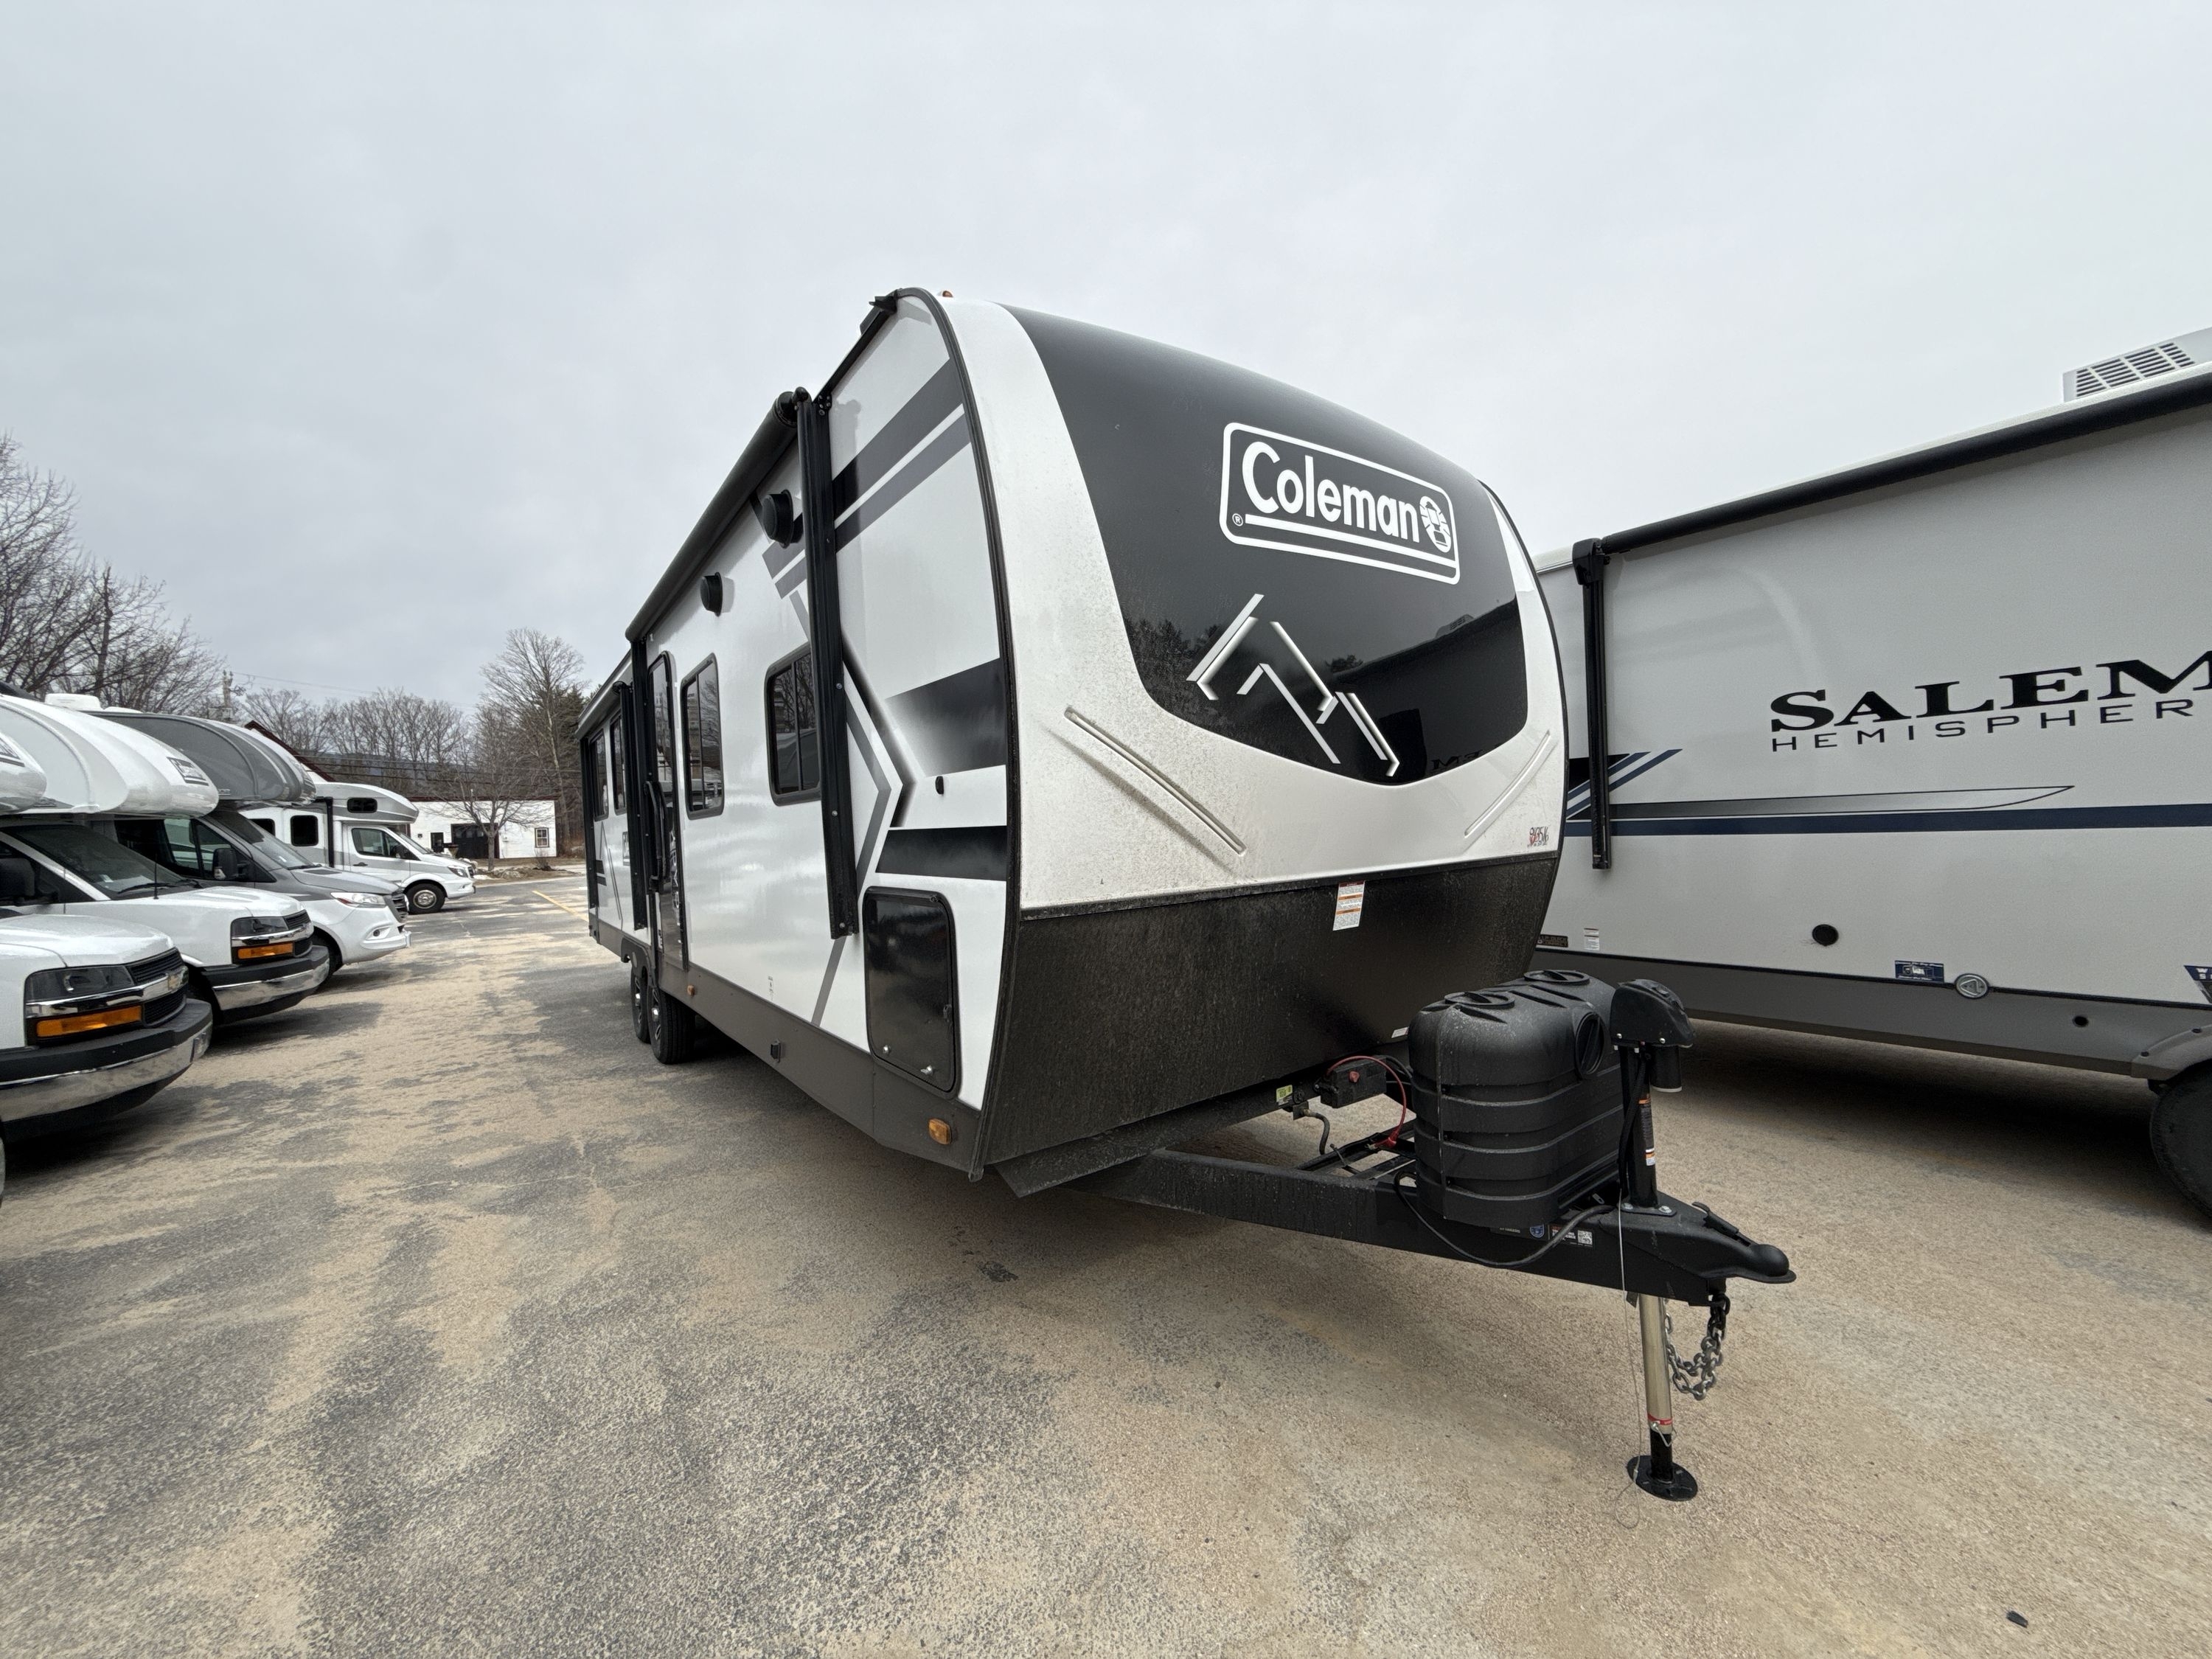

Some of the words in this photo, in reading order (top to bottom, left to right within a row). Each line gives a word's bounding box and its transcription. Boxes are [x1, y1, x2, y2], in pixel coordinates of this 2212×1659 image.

[1242, 441, 1420, 543] Coleman
[1770, 650, 2212, 732] SALEM
[1772, 698, 2194, 752] HEMISPHER
